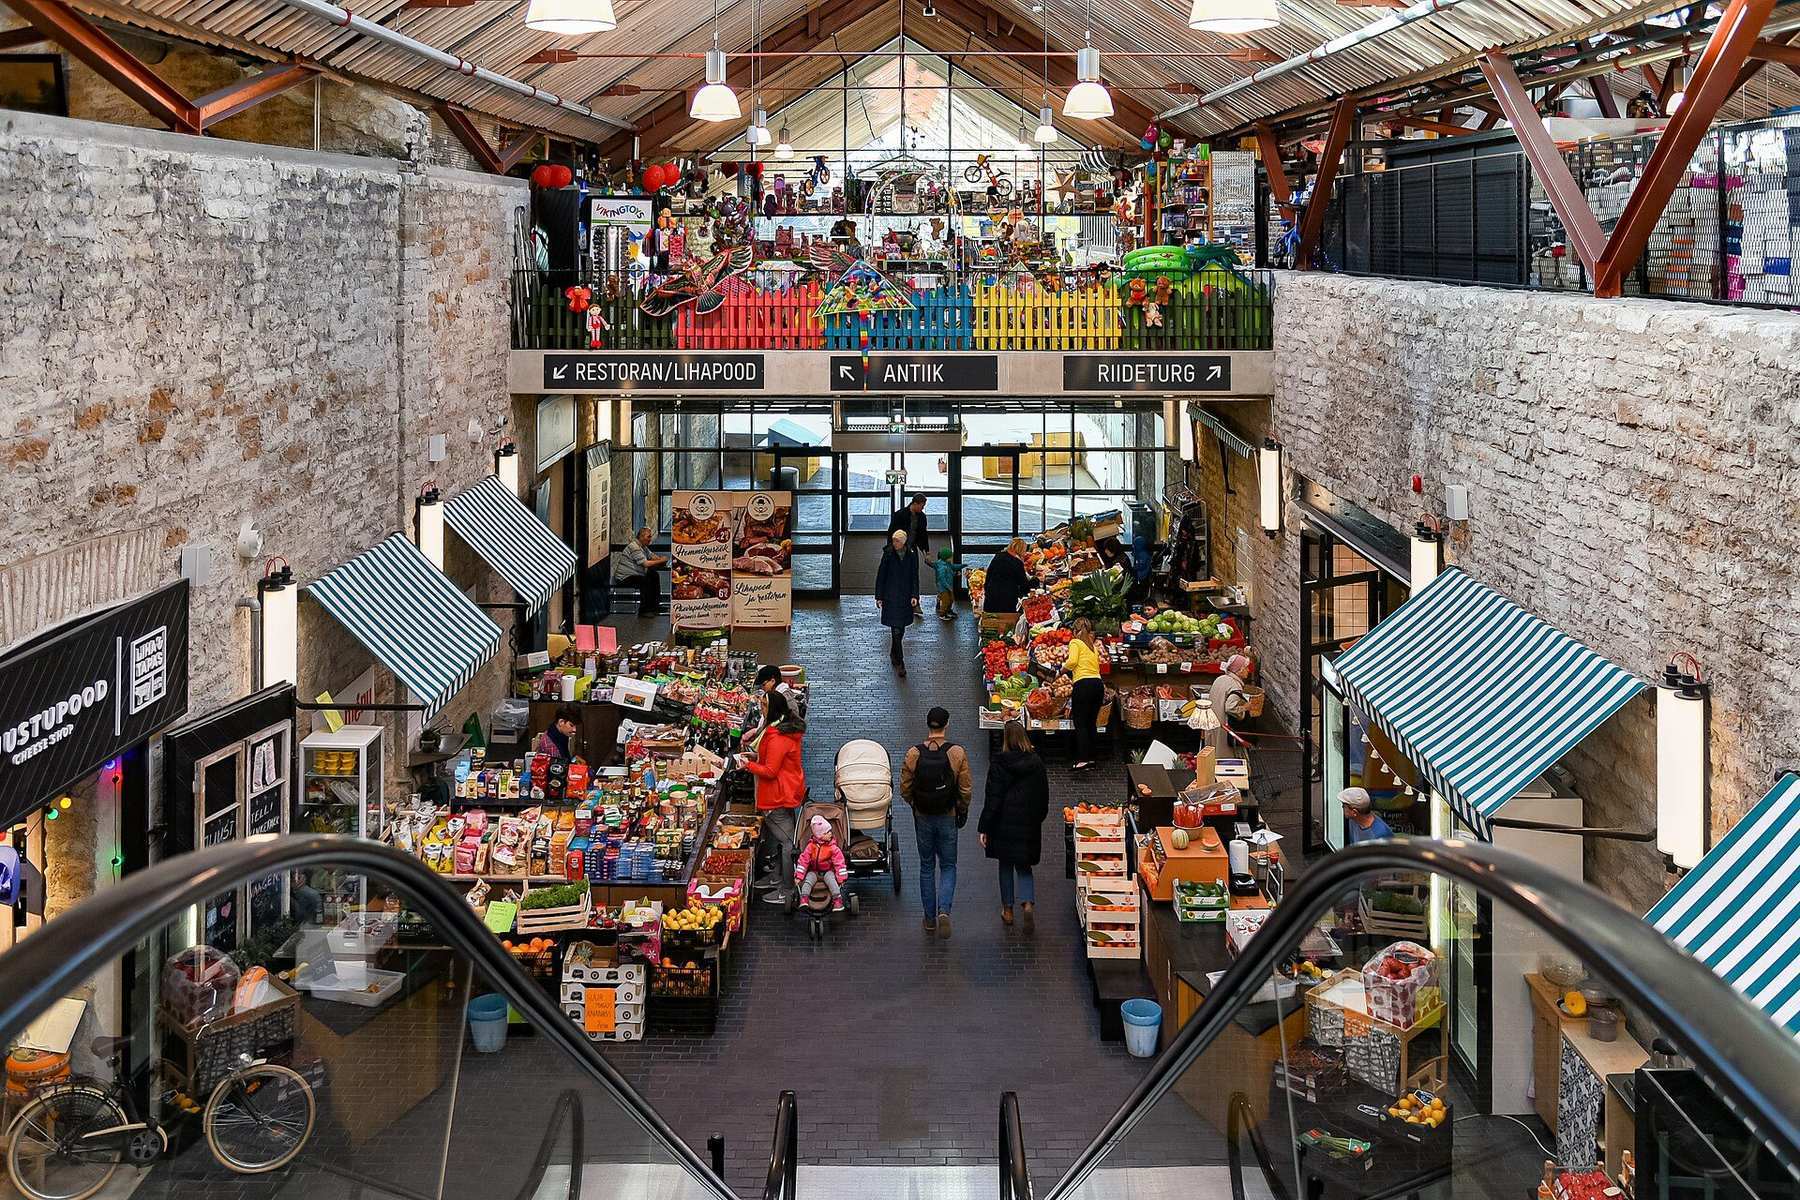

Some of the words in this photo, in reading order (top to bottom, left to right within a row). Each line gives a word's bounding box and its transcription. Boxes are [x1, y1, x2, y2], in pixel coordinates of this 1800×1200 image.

[596, 203, 645, 219] VIKINGTOYS
[576, 362, 757, 382] RESTORAN/LIHAPOOD
[883, 363, 945, 383] ANTIIK
[1098, 363, 1196, 383] RIIDETURG
[744, 595, 757, 606] ja
[135, 651, 164, 677] TAPAS
[0, 679, 109, 756] USTUPOOD
[12, 738, 48, 765] CHEESE
[48, 724, 75, 746] SHOP
